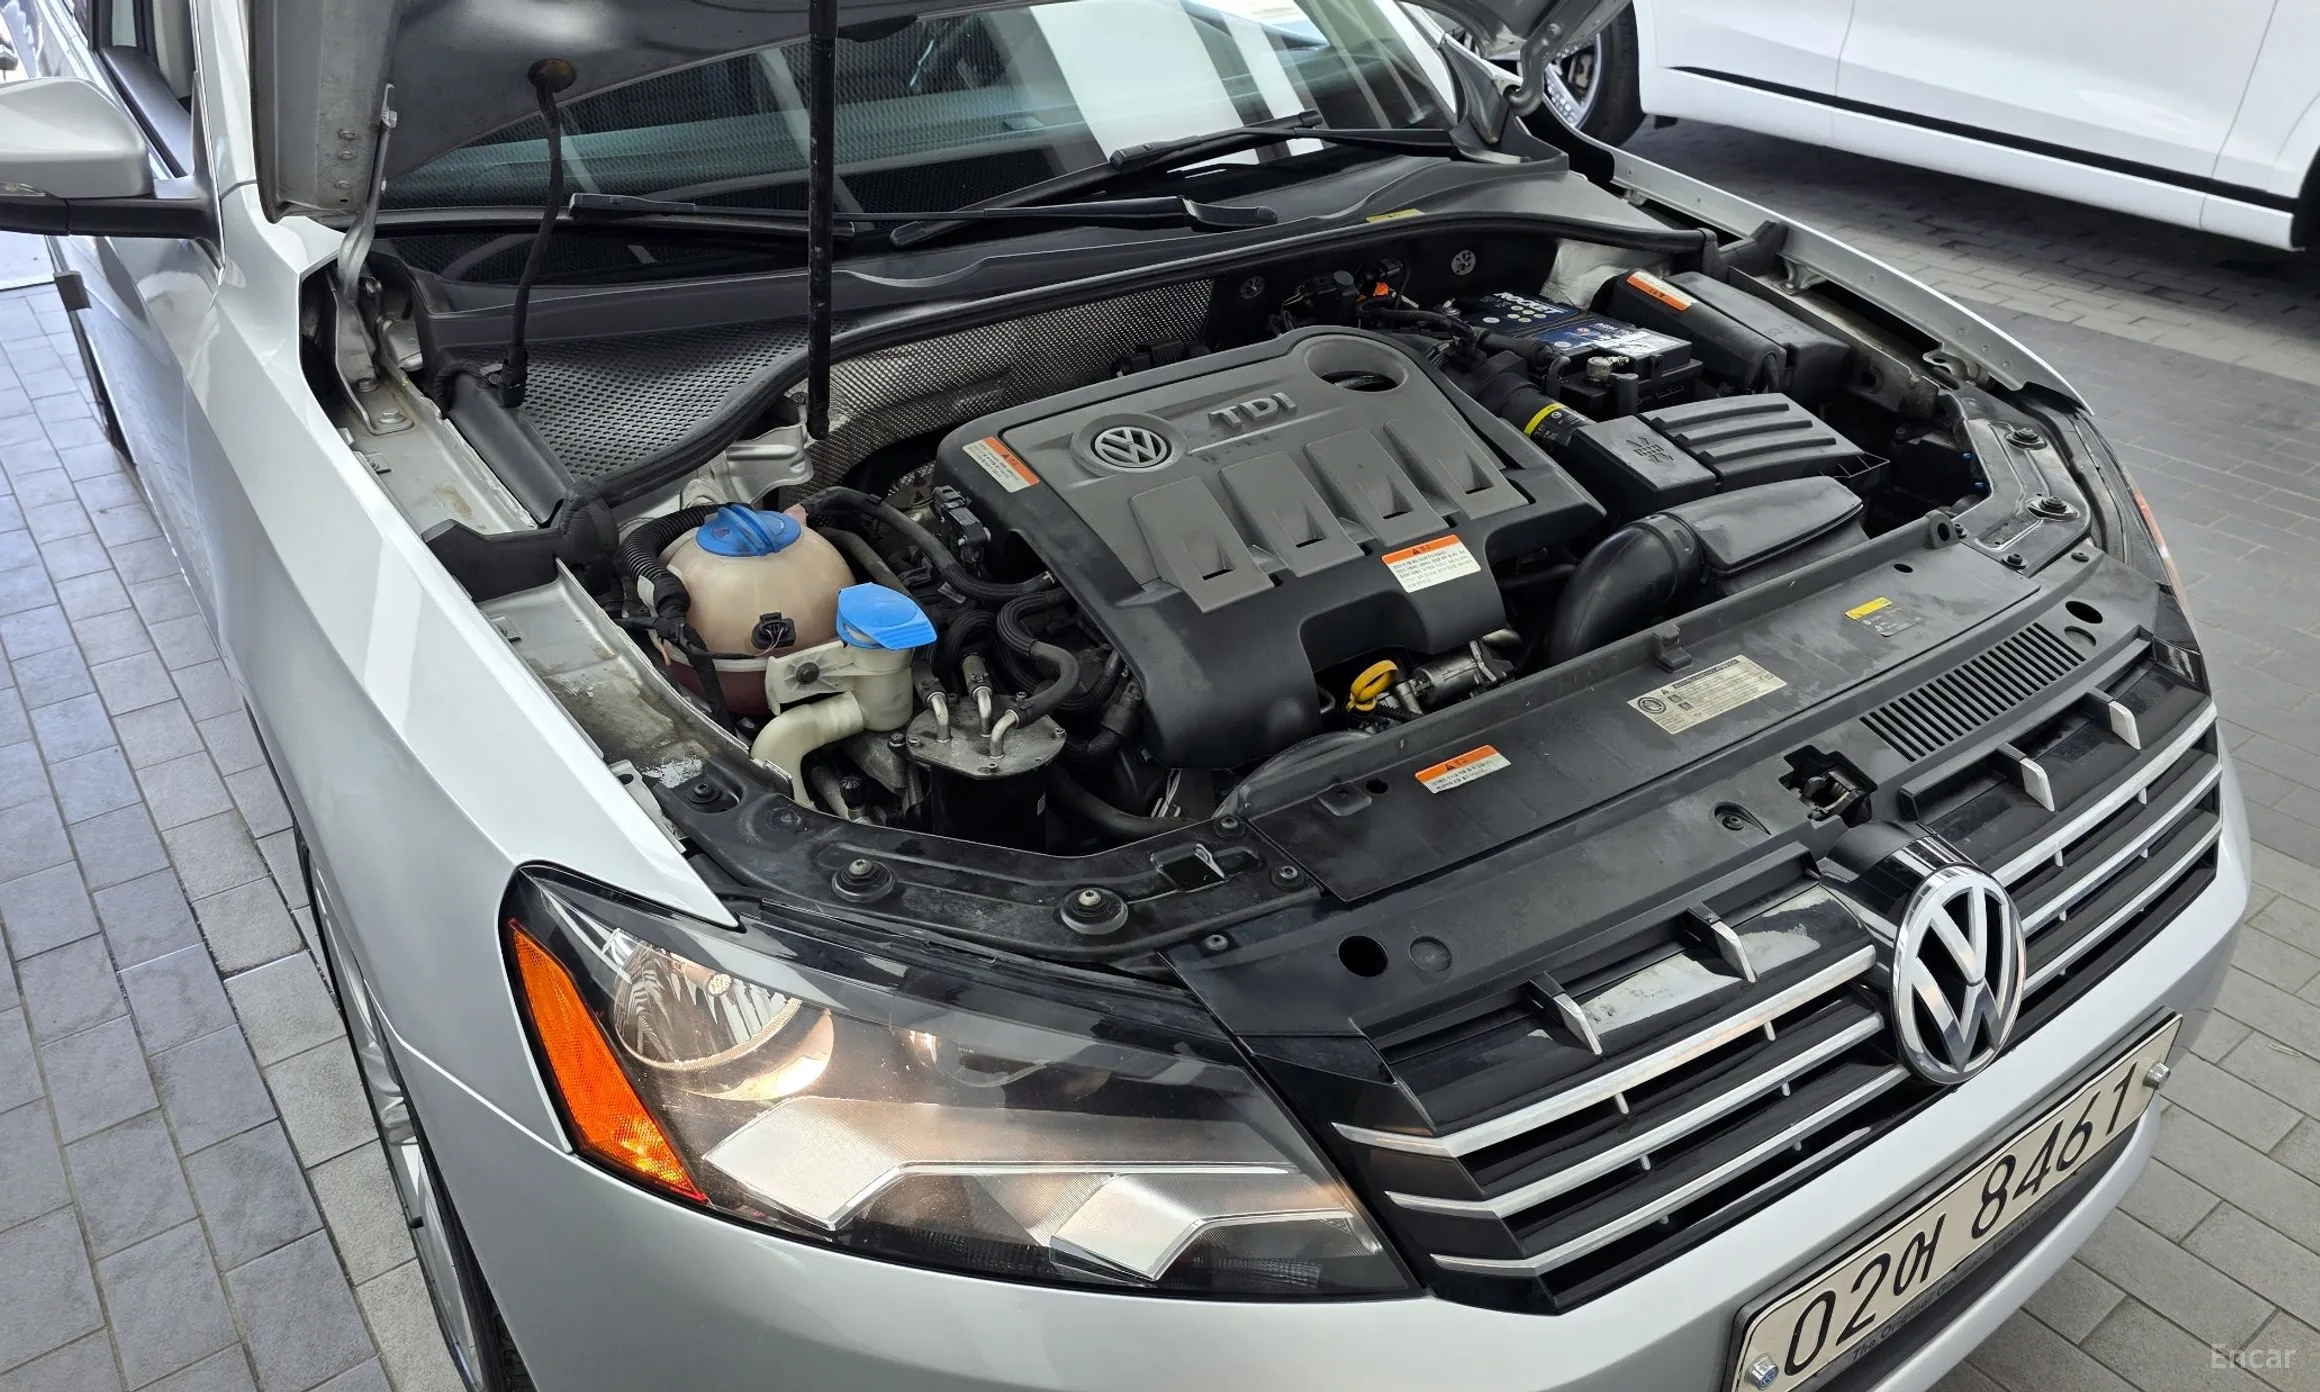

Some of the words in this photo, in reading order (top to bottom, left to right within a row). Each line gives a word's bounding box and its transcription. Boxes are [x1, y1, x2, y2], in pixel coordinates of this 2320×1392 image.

[1208, 391, 1298, 429] TDI
[1783, 1212, 1947, 1377] 02어
[1970, 1061, 2138, 1241] 8461
[1852, 1338, 1877, 1361] The
[1881, 1294, 1935, 1340] Original
